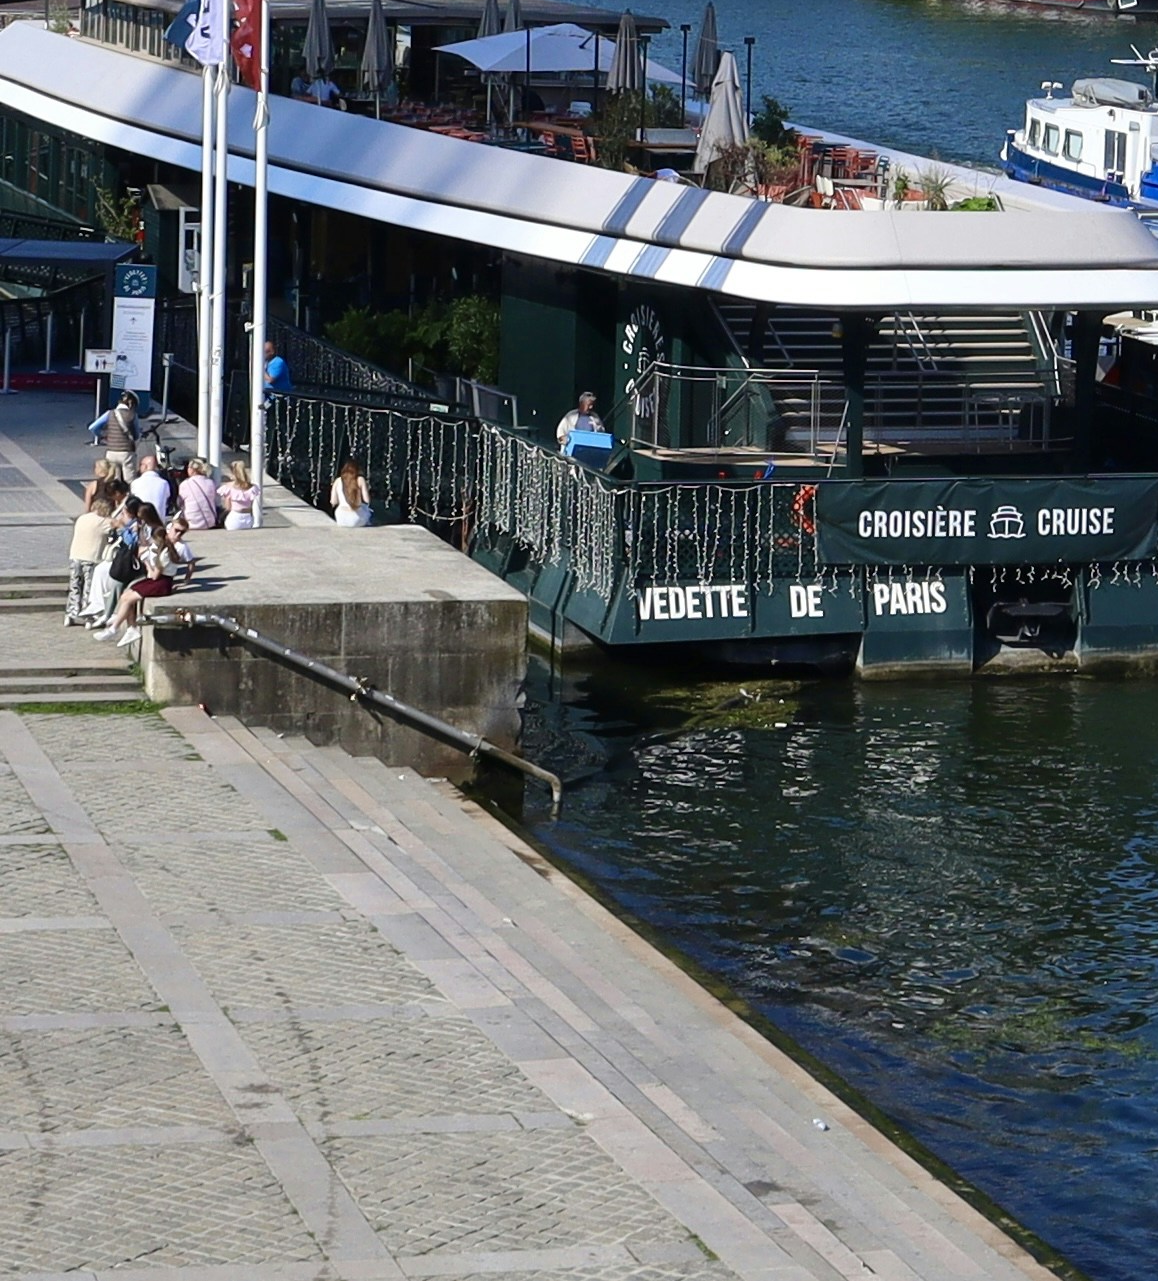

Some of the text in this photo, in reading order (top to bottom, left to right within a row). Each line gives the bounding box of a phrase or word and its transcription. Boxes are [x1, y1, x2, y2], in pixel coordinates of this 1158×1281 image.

[858, 505, 1115, 538] CROISIÈRE CRUISE
[639, 581, 947, 620] VEDETTE DE PARIS
